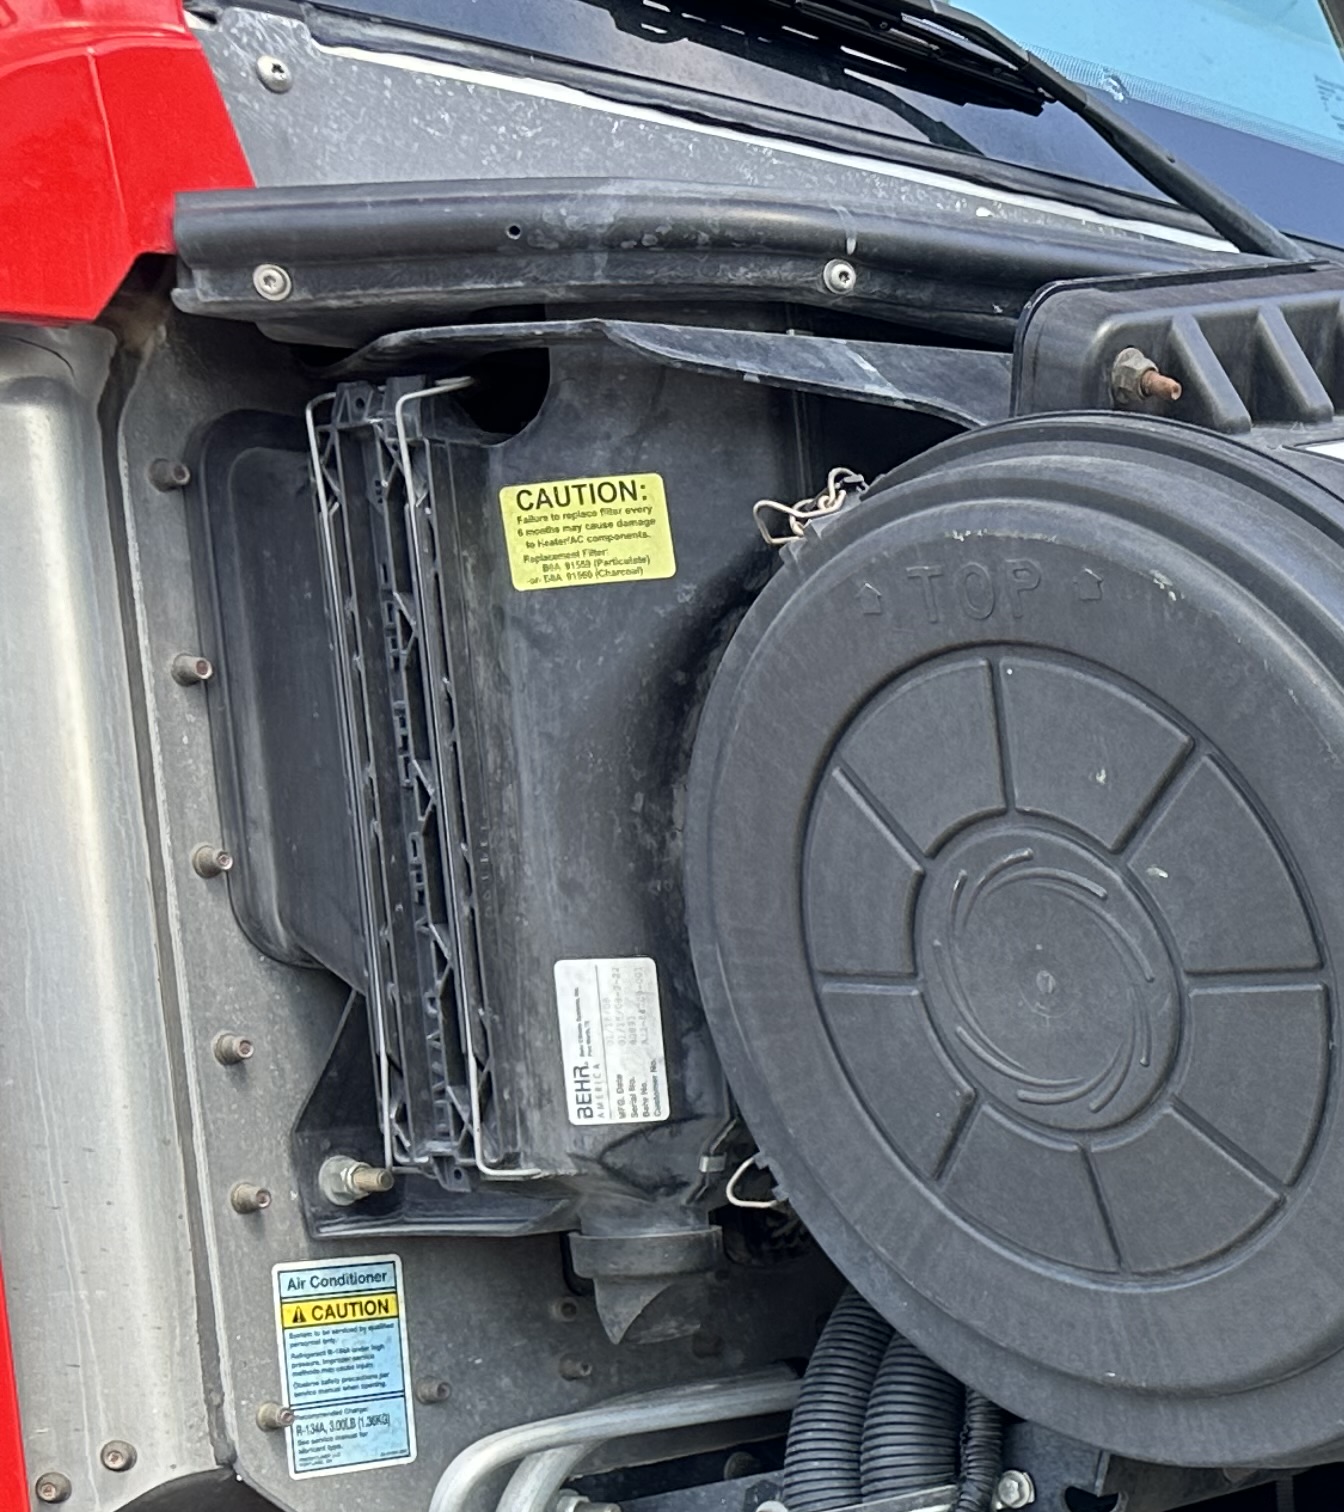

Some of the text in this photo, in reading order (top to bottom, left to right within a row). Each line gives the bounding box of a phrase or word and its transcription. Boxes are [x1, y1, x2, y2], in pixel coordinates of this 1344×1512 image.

[516, 479, 648, 511] CAUTION:
[517, 505, 653, 525] Failure to replace filter every
[526, 526, 560, 536] months
[563, 523, 583, 534] may
[585, 521, 614, 531] cause
[616, 517, 656, 529] damage
[526, 540, 536, 549] to
[906, 557, 1042, 624] TOP
[573, 1063, 594, 1119] BEHR
[595, 1063, 606, 1118] AMERICA
[287, 1271, 387, 1291] Air Conditioner
[312, 1298, 390, 1321] CAUTION
